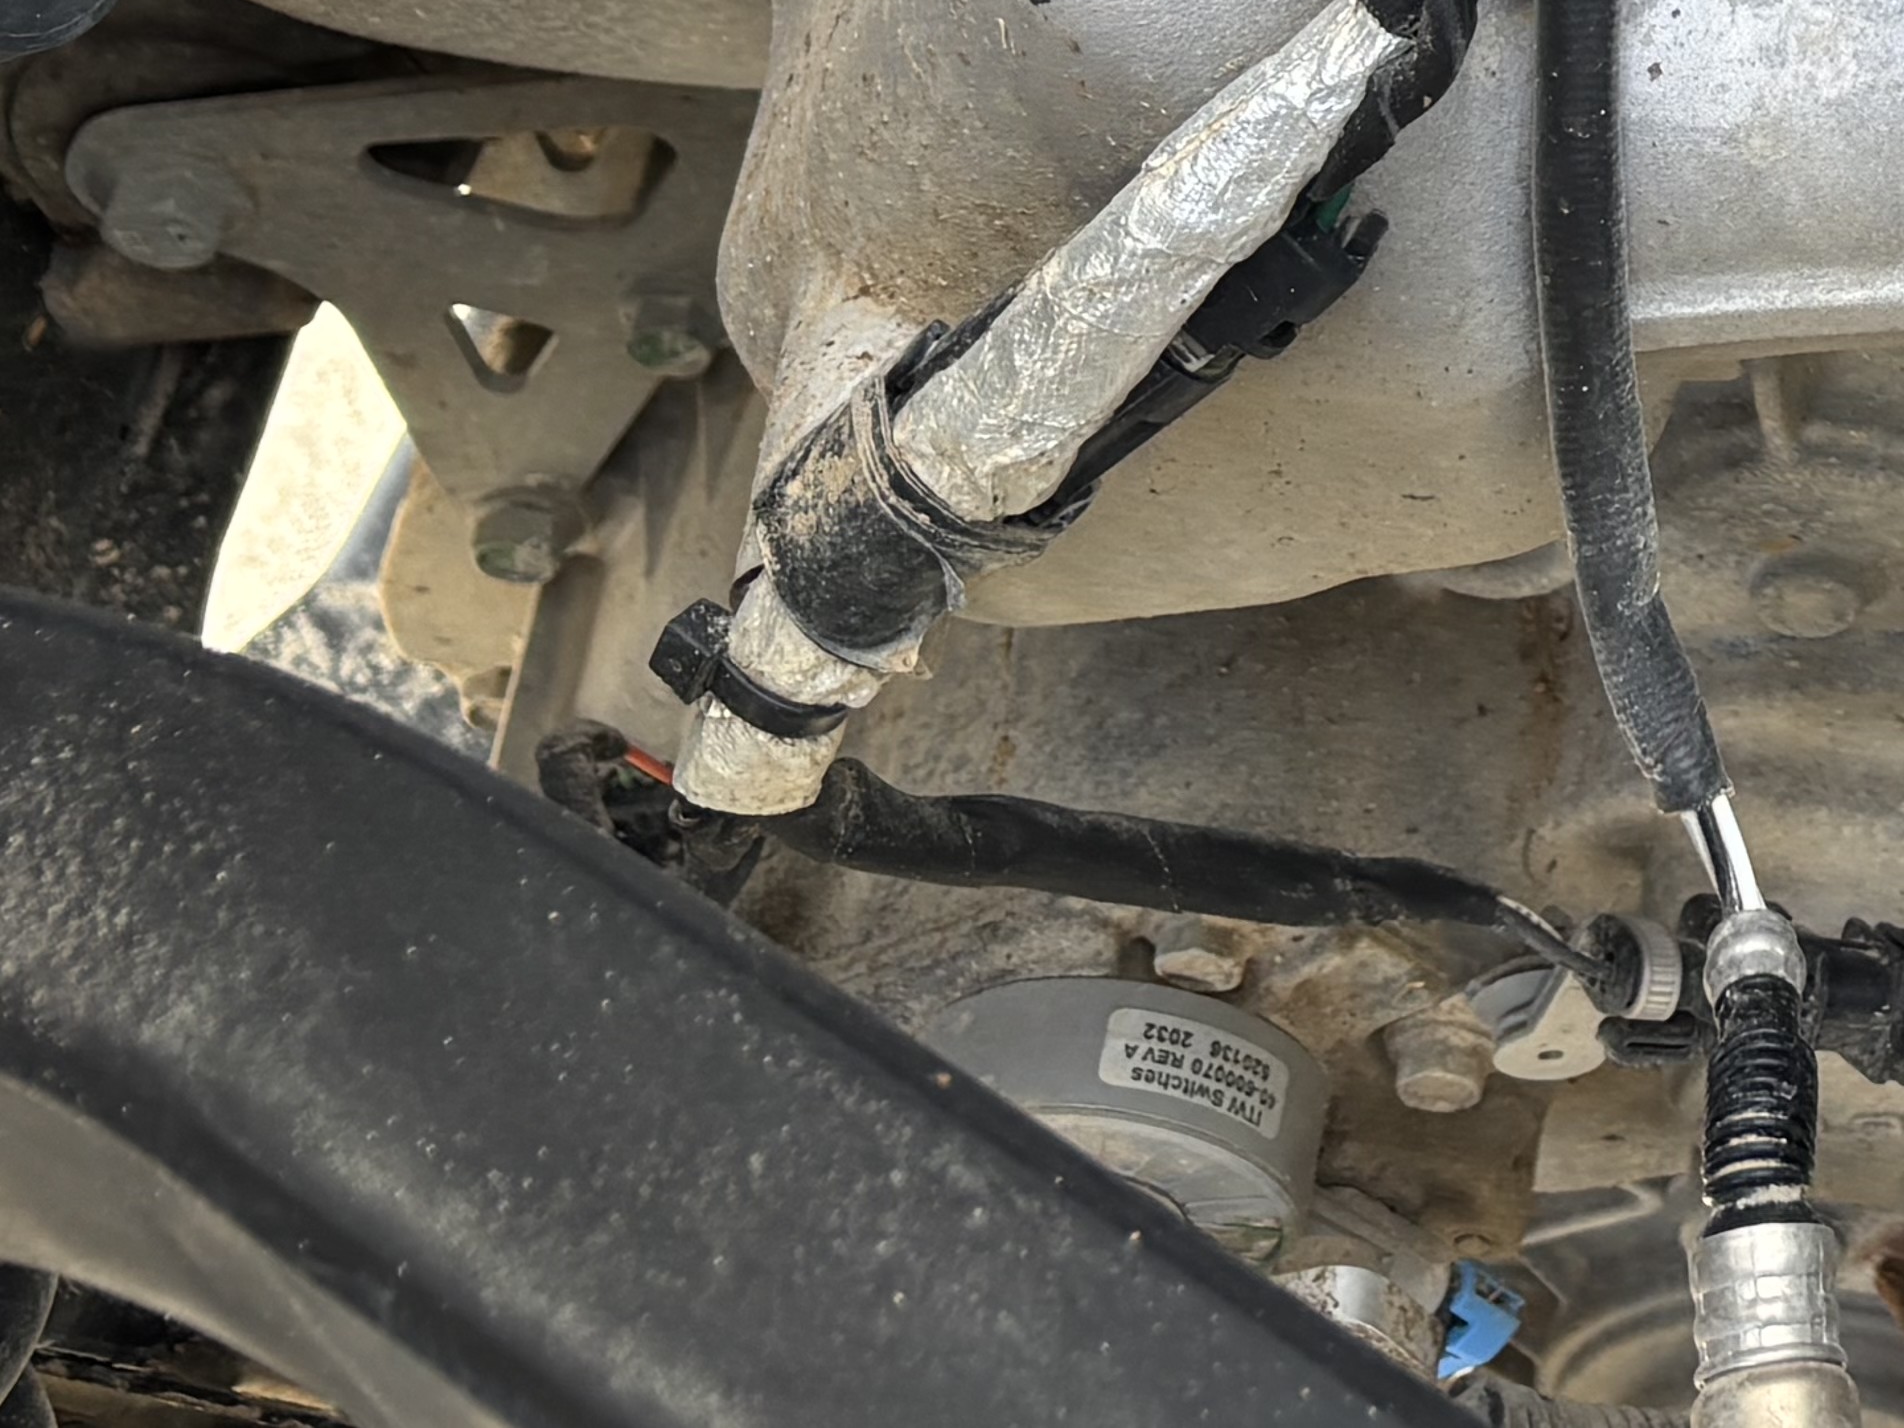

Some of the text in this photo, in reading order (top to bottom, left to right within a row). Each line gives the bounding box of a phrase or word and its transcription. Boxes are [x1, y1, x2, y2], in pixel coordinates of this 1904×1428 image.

[1142, 1022, 1194, 1049] 2032
[1123, 1043, 1139, 1059] A
[1141, 1046, 1185, 1069] REV
[1130, 1066, 1263, 1127] ITW Switches
